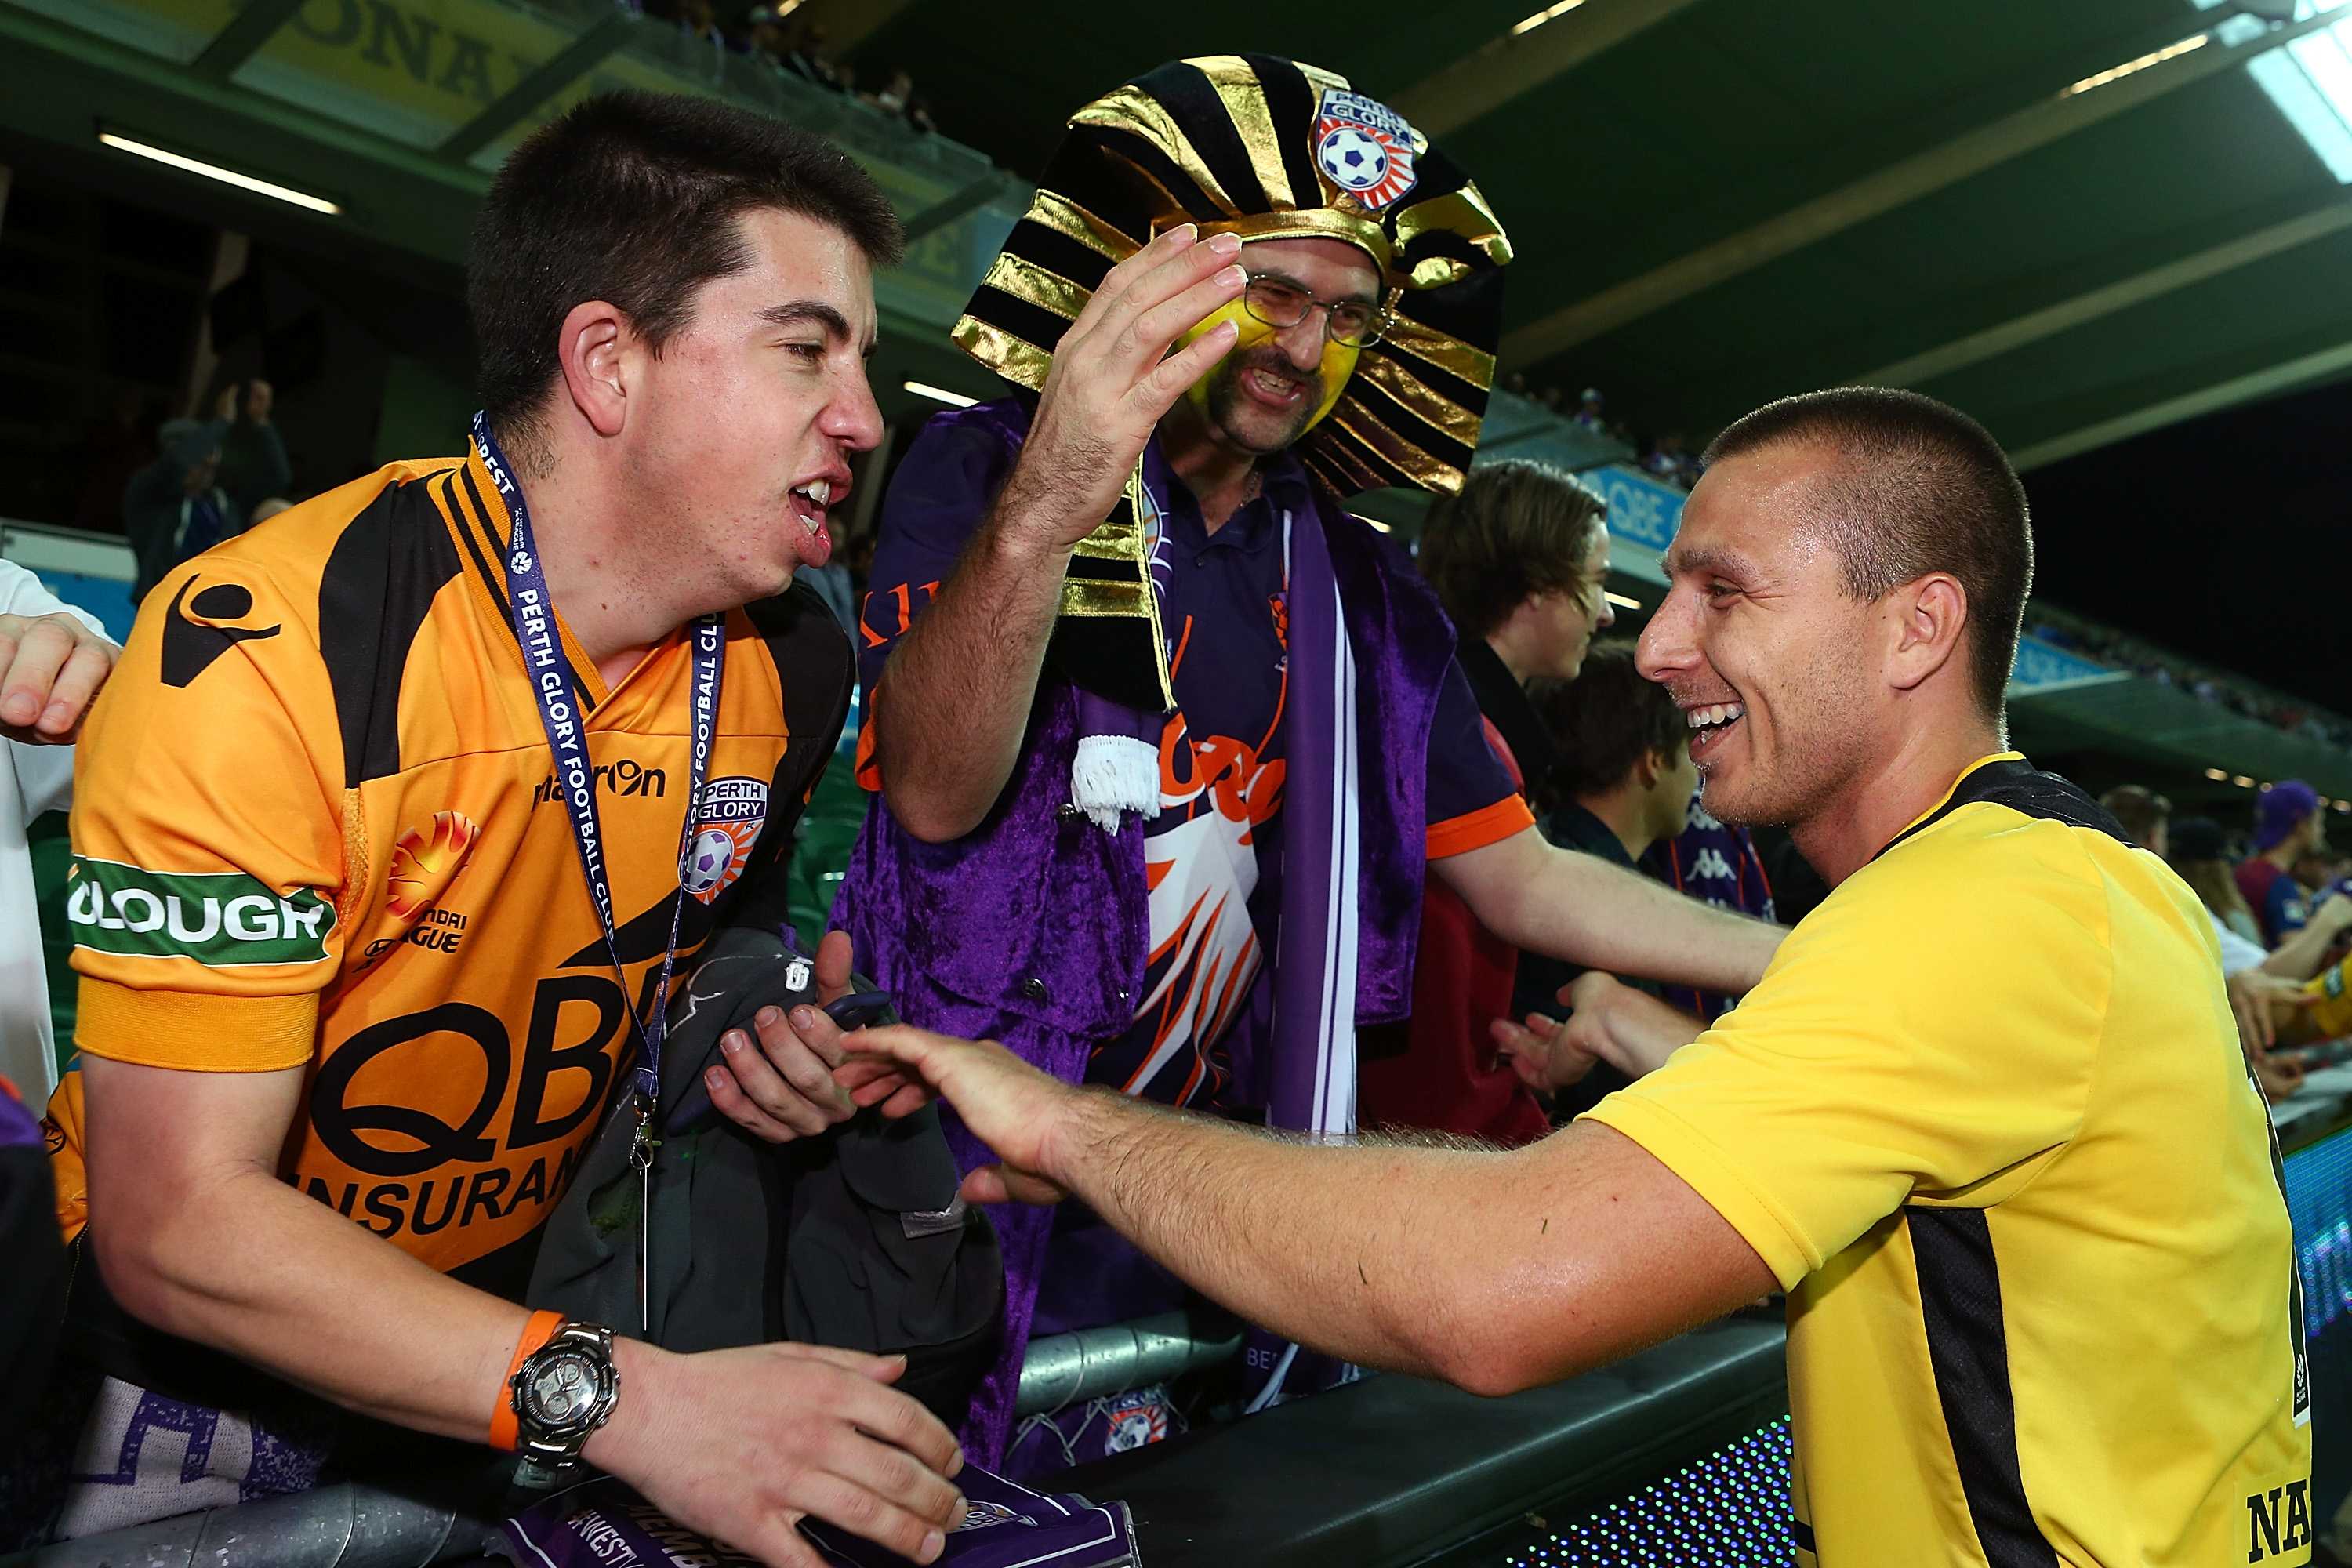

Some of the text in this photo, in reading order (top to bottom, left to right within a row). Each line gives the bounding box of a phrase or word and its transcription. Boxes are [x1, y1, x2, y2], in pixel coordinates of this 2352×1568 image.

[1331, 103, 1408, 138] GLORY
[1607, 481, 1665, 543] QBE
[517, 589, 556, 667] PERTH
[540, 672, 579, 750] GLORY
[564, 757, 600, 880] FOOTBALL
[695, 656, 716, 771] FOOTBALL
[698, 801, 760, 818] GLORY
[702, 782, 760, 802] PERTH
